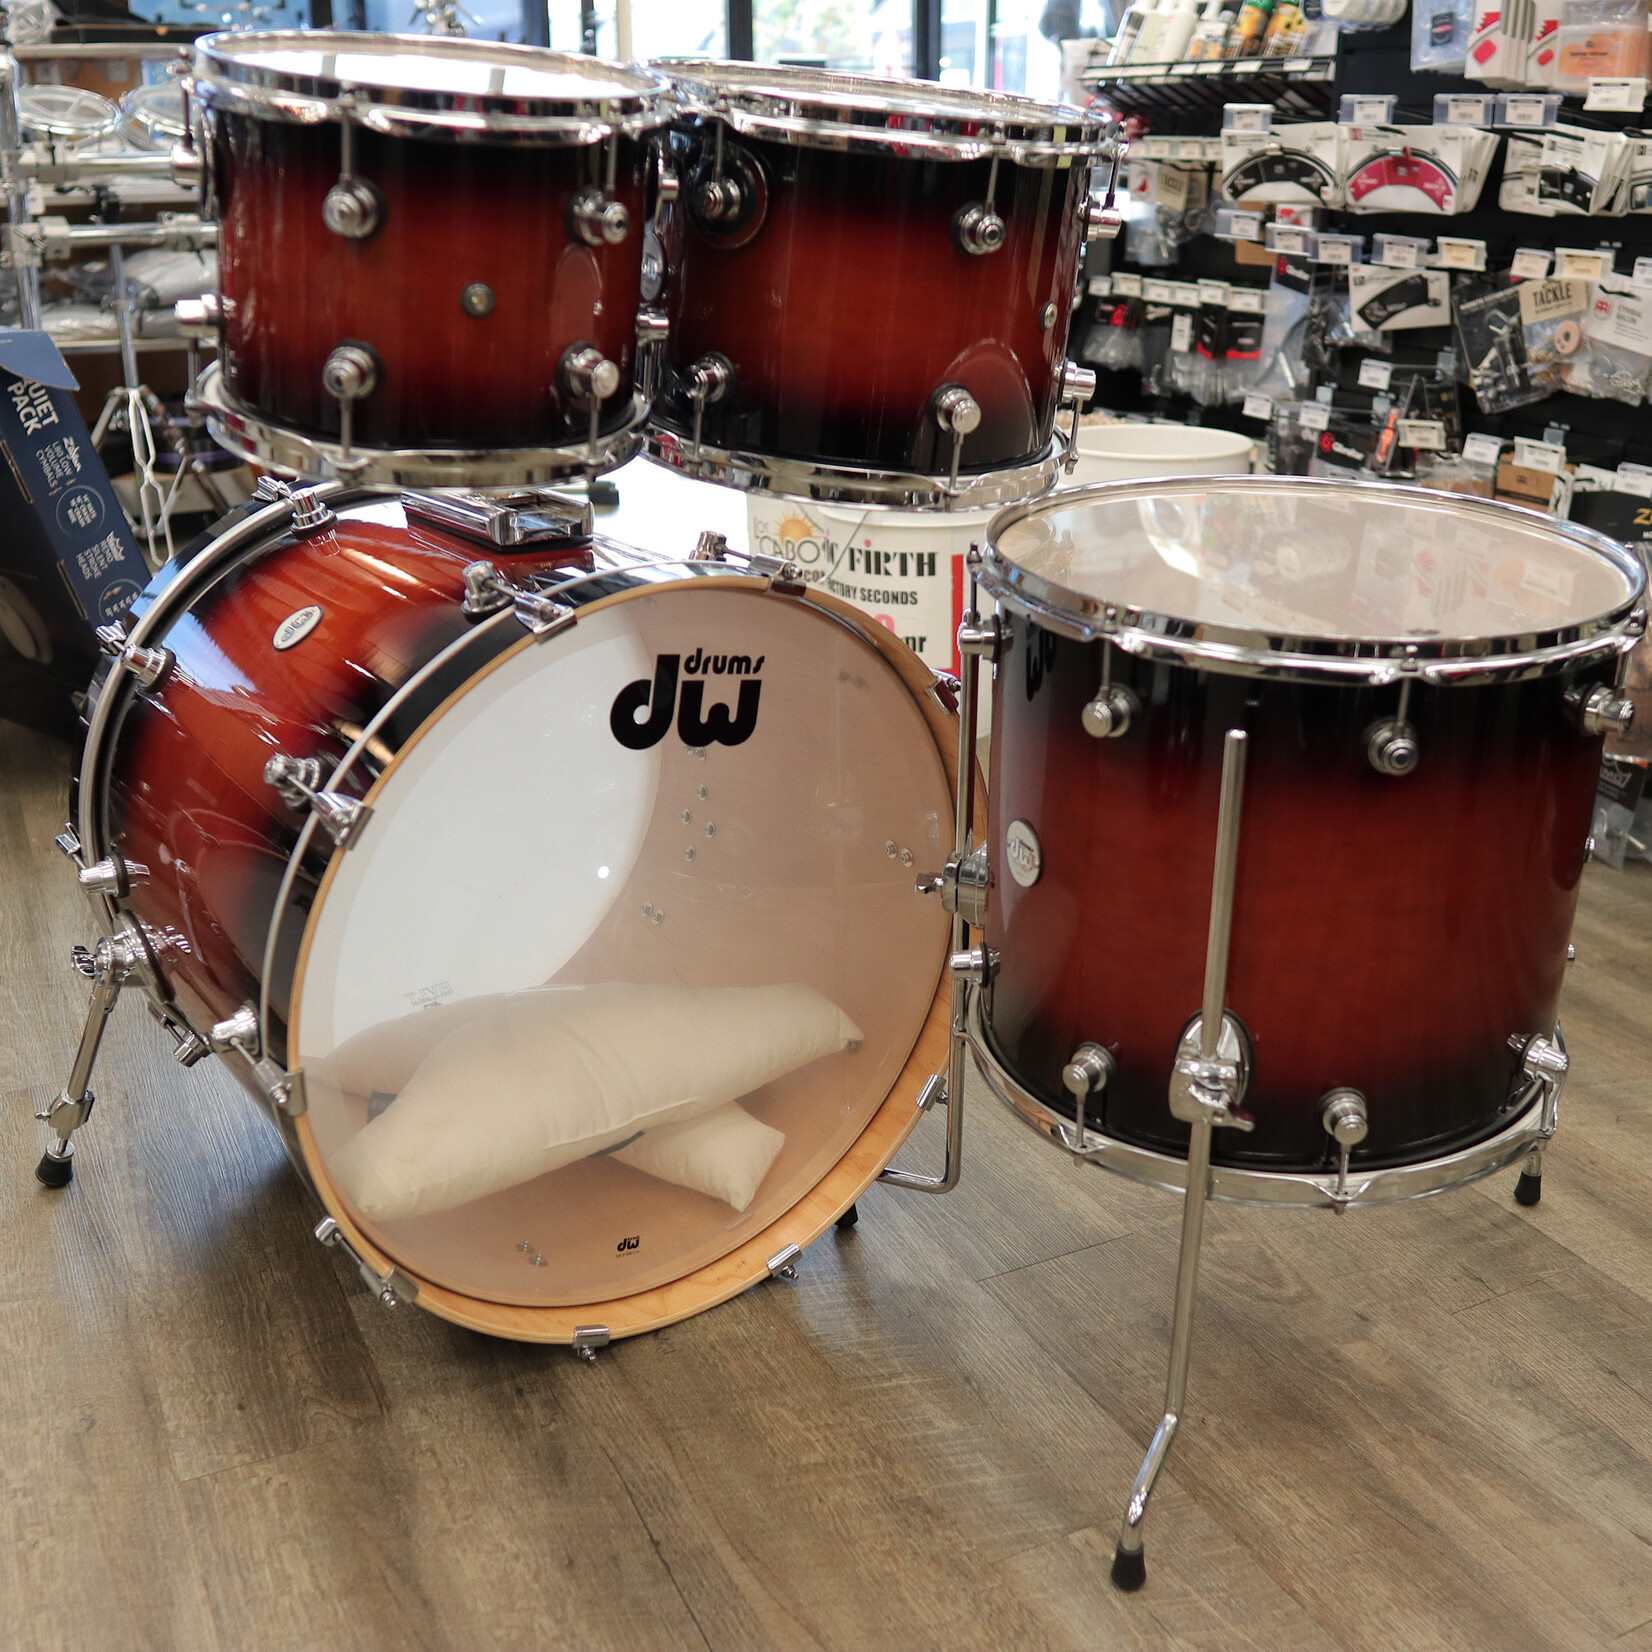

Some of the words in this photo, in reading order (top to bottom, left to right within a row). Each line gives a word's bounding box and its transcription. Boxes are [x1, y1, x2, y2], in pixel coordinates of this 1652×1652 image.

[1533, 281, 1572, 307] TACKLE
[7, 381, 42, 436] PACK
[22, 379, 59, 425] UIET
[36, 449, 58, 488] CYMBALS
[44, 444, 64, 479] VOLUME
[59, 456, 73, 476] LOW
[92, 543, 109, 570] SILENT
[100, 540, 114, 563] REMO
[759, 535, 826, 563] CABO
[76, 552, 92, 580] HEADS
[84, 548, 102, 579] STROKE
[860, 586, 918, 605] SECONDS
[684, 648, 765, 674] drums
[610, 654, 762, 750] dw
[617, 1237, 640, 1252] dw
